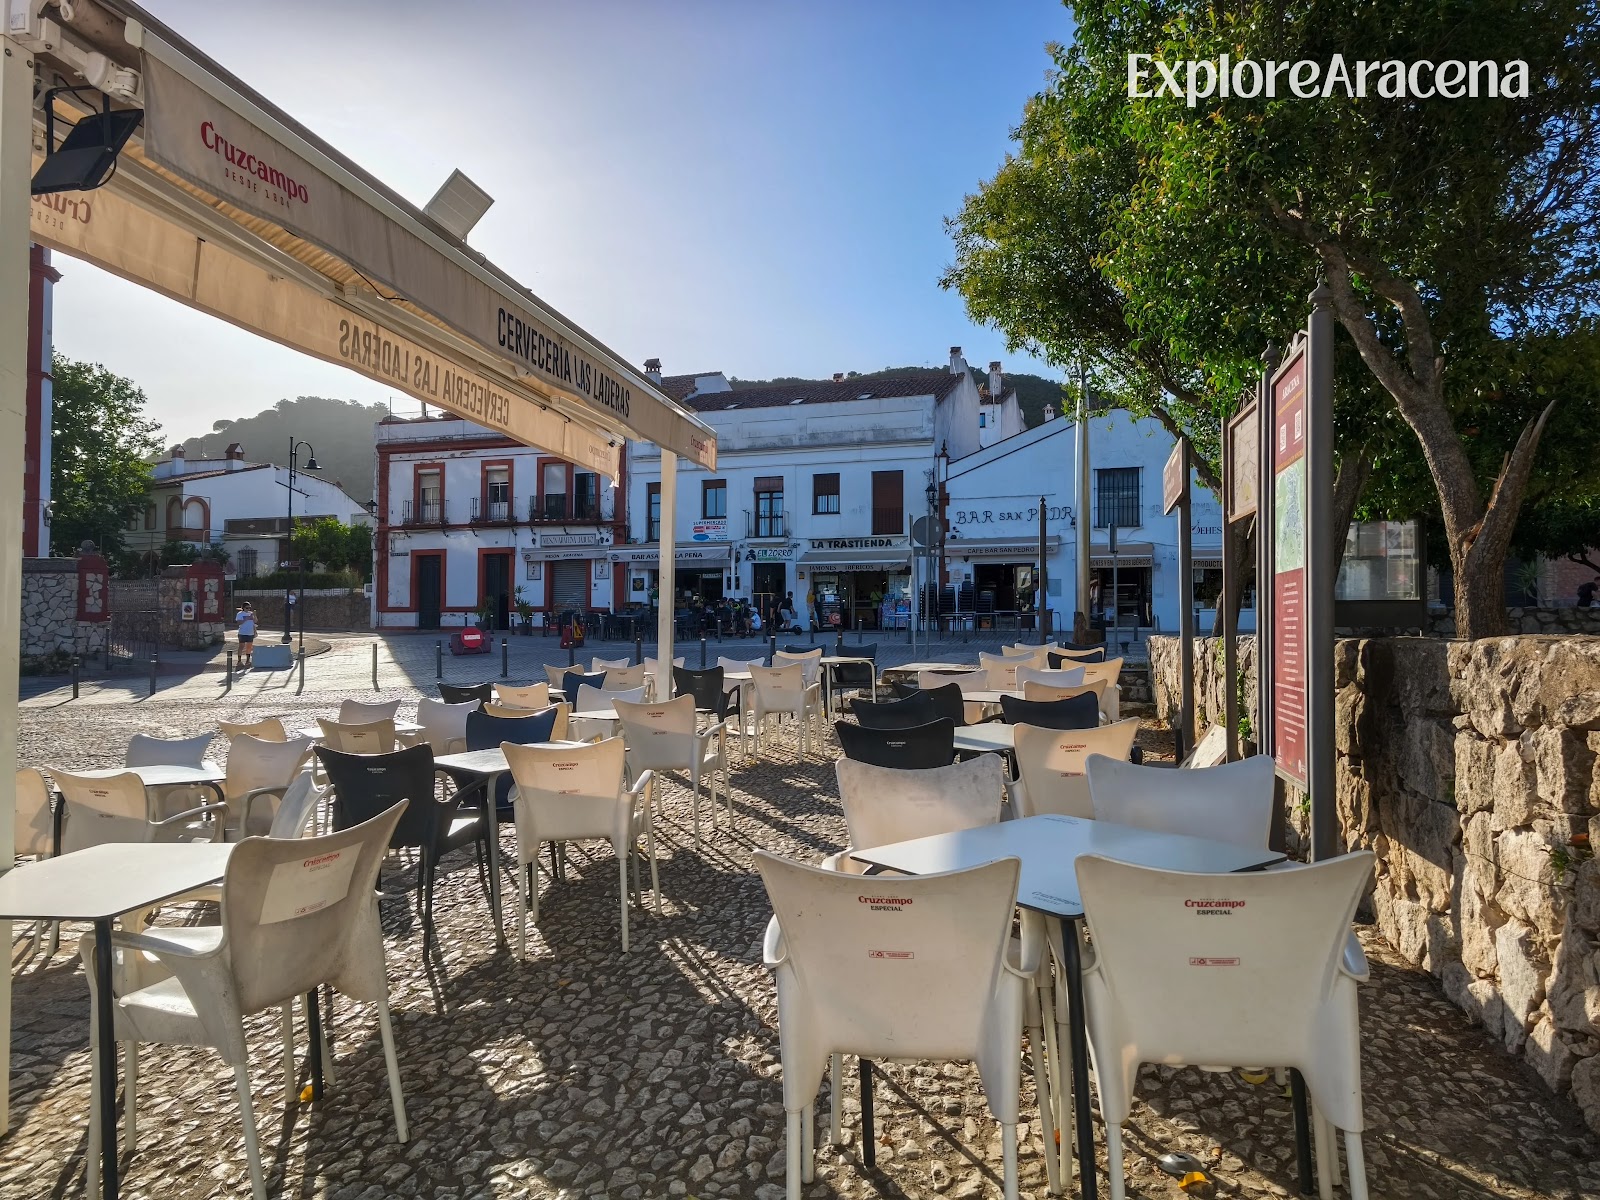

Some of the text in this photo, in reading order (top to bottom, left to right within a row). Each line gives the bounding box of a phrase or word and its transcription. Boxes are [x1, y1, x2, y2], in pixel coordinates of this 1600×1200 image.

[200, 121, 309, 204] Cruzcampo
[224, 167, 257, 193] DESDE
[497, 307, 630, 418] CERVECERÍA LAS LADERAS
[955, 510, 994, 524] BAR
[999, 511, 1023, 521] SAN
[812, 538, 893, 549] LA TRASTIENDA
[858, 895, 913, 905] Cruzcampo
[1184, 899, 1246, 909] Cruzcampo
